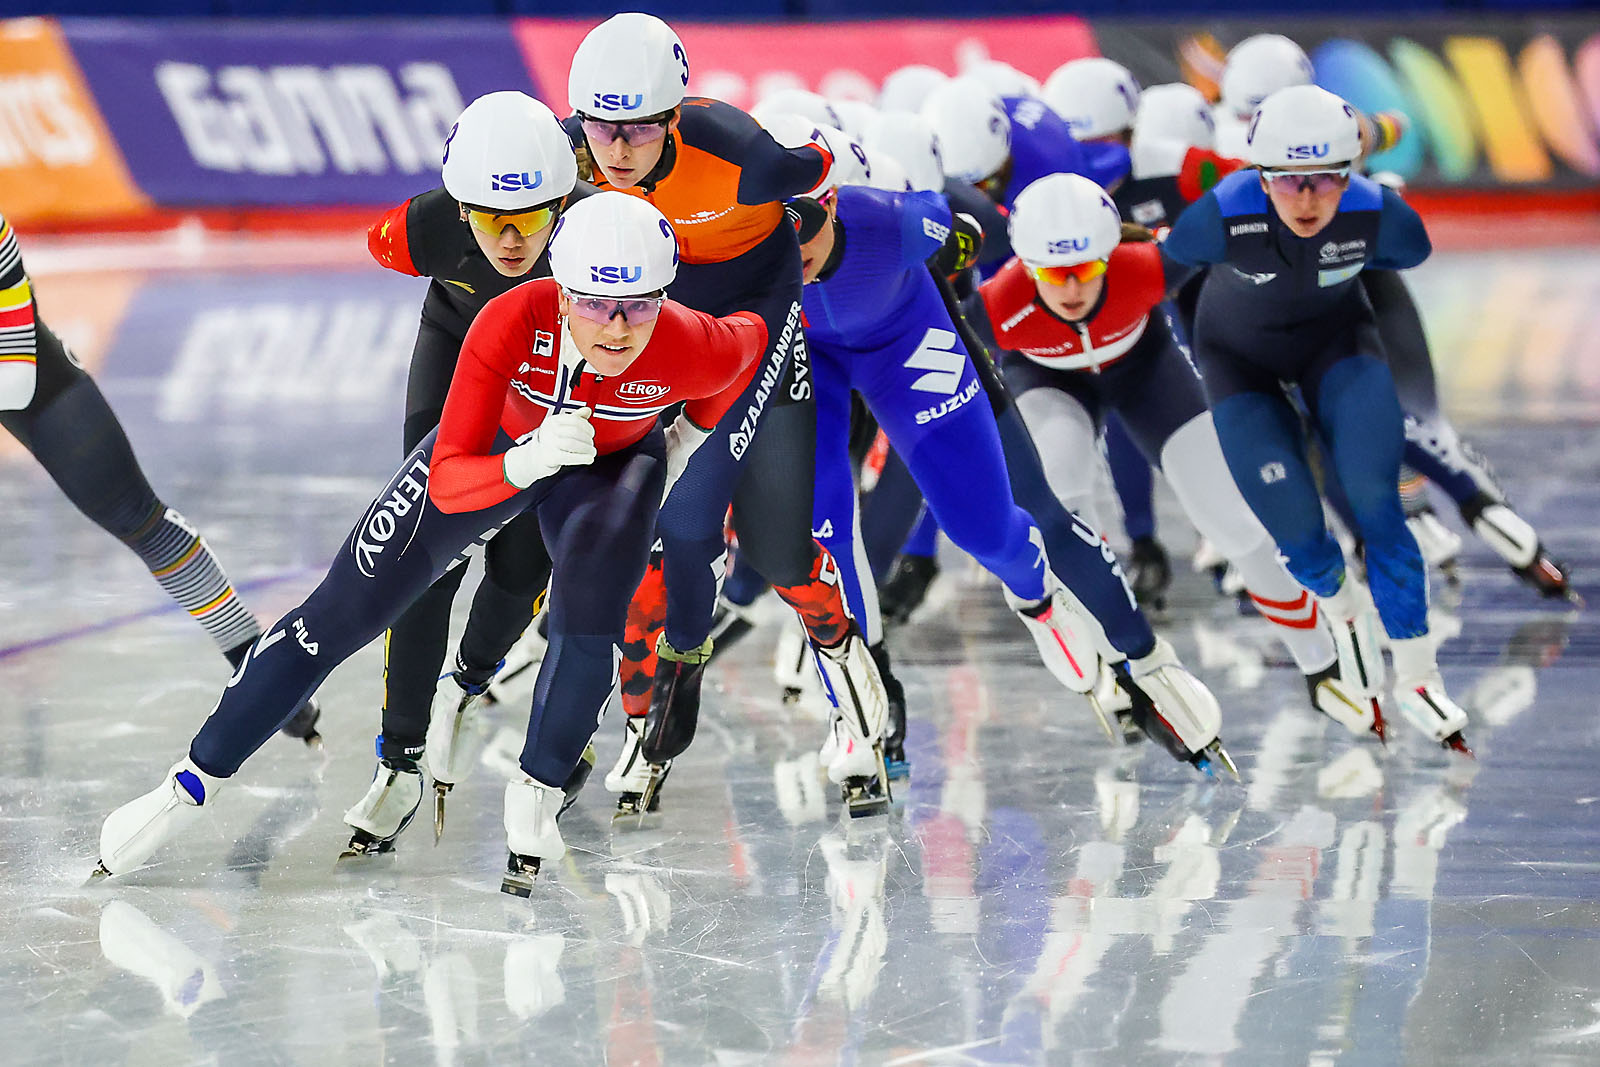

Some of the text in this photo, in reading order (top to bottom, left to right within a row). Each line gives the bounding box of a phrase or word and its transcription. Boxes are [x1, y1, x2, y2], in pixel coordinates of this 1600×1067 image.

[593, 93, 643, 111] ISU
[491, 170, 543, 192] ISU
[590, 265, 642, 284] ISU
[740, 300, 802, 442] ZAANLANDER
[619, 382, 668, 397] LERØY
[914, 378, 981, 425] SUZUKI
[360, 459, 430, 569] LERØY
[292, 616, 319, 656] FILA
